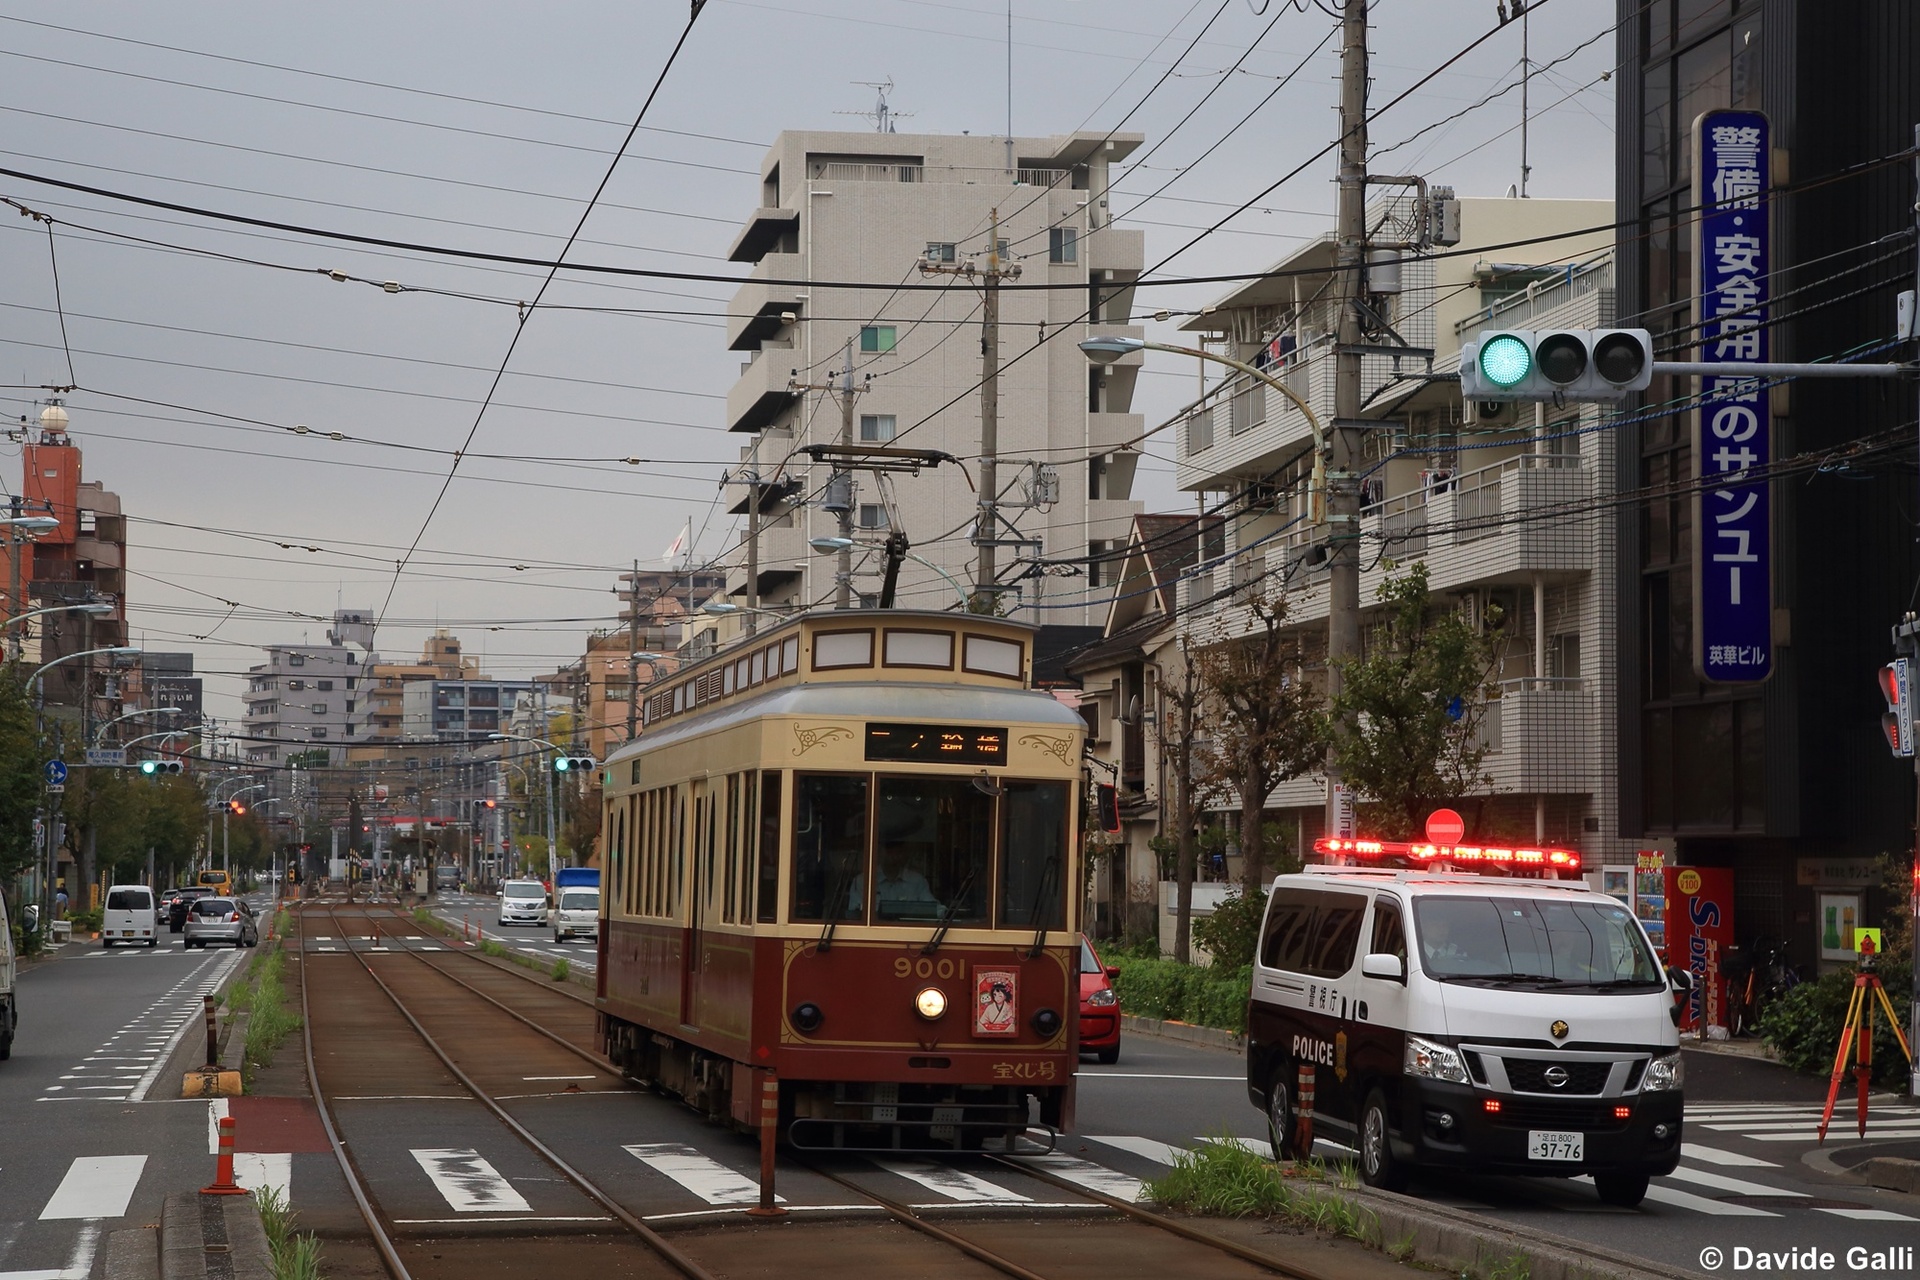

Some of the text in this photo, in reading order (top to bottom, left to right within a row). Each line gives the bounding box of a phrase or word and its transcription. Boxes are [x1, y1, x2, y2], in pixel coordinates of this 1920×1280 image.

[1711, 126, 1761, 605] 警備・安全用品のサンユー
[1709, 645, 1765, 666] 英華ビル
[893, 956, 966, 981] 9001
[1292, 1034, 1333, 1067] POLICE
[992, 1062, 1057, 1081] 宝くじ号
[1540, 1142, 1581, 1159] 97-76
